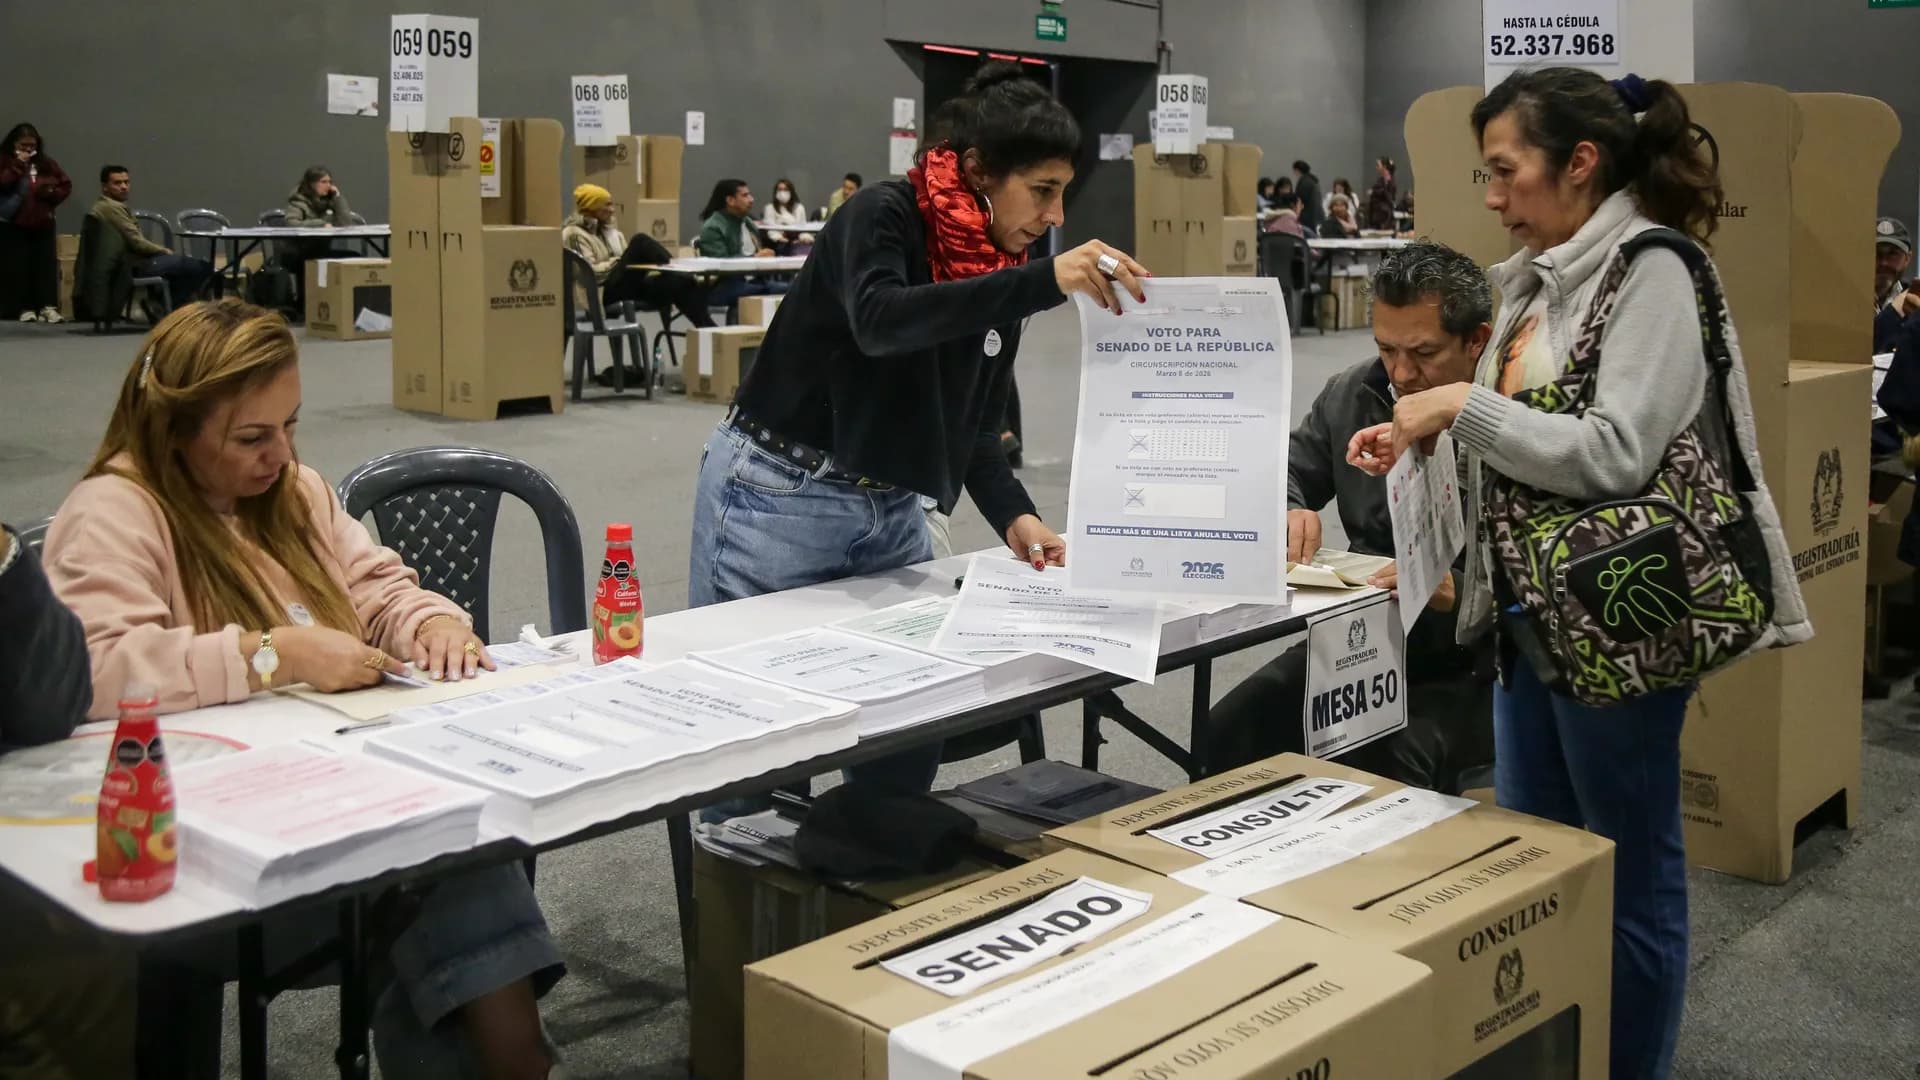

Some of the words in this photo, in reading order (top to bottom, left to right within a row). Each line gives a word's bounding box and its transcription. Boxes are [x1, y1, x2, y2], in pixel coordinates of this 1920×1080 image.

[1504, 17, 1537, 29] HASTA
[1540, 16, 1553, 28] LA
[1556, 14, 1600, 28] CÉDULA
[393, 28, 422, 56] 059
[428, 29, 472, 59] 059
[1491, 34, 1615, 56] 52.337.968
[575, 84, 600, 102] 068
[604, 84, 628, 100] 068
[1160, 84, 1189, 103] 058
[1192, 84, 1207, 104] 058
[1146, 327, 1182, 338] VOTO
[1186, 327, 1222, 337] PARA
[1096, 342, 1150, 352] SENADO
[1154, 342, 1172, 352] DE
[1176, 342, 1192, 352] LA
[1197, 339, 1275, 352] REPÚBLICA
[1090, 527, 1121, 535] MARCAR
[1122, 526, 1140, 536] MÁS
[1141, 528, 1151, 536] DE
[1152, 528, 1169, 536] UNA
[1170, 530, 1192, 538] LISTA
[1194, 530, 1220, 539] ANULA
[1222, 531, 1232, 539] EL
[1234, 532, 1254, 540] VOTO
[978, 582, 1032, 594] SENADO
[1028, 584, 1062, 592] VOTO
[1312, 679, 1368, 732] MESA
[1372, 668, 1398, 709] 50
[1112, 797, 1188, 827] DEPOSITE
[1188, 792, 1204, 802] SU
[1203, 778, 1242, 796] VOTO
[1180, 783, 1345, 848] CONSULTA
[1268, 831, 1327, 853] CERRADA
[1347, 802, 1400, 824] SELLADA
[1479, 846, 1551, 879] DEPOSITE
[1462, 873, 1490, 888] SU
[1425, 884, 1472, 905] VOTO
[848, 912, 948, 953] DEPOSITE
[942, 900, 973, 918] SU
[972, 885, 1020, 909] VOTO
[1019, 867, 1065, 890] AQUÍ
[1458, 893, 1558, 962] CONSULTAS
[916, 896, 1123, 984] SENADO
[1250, 980, 1344, 1028] DEPOSITE
[1224, 1021, 1260, 1042] SU
[1173, 1036, 1236, 1067] VOTO
